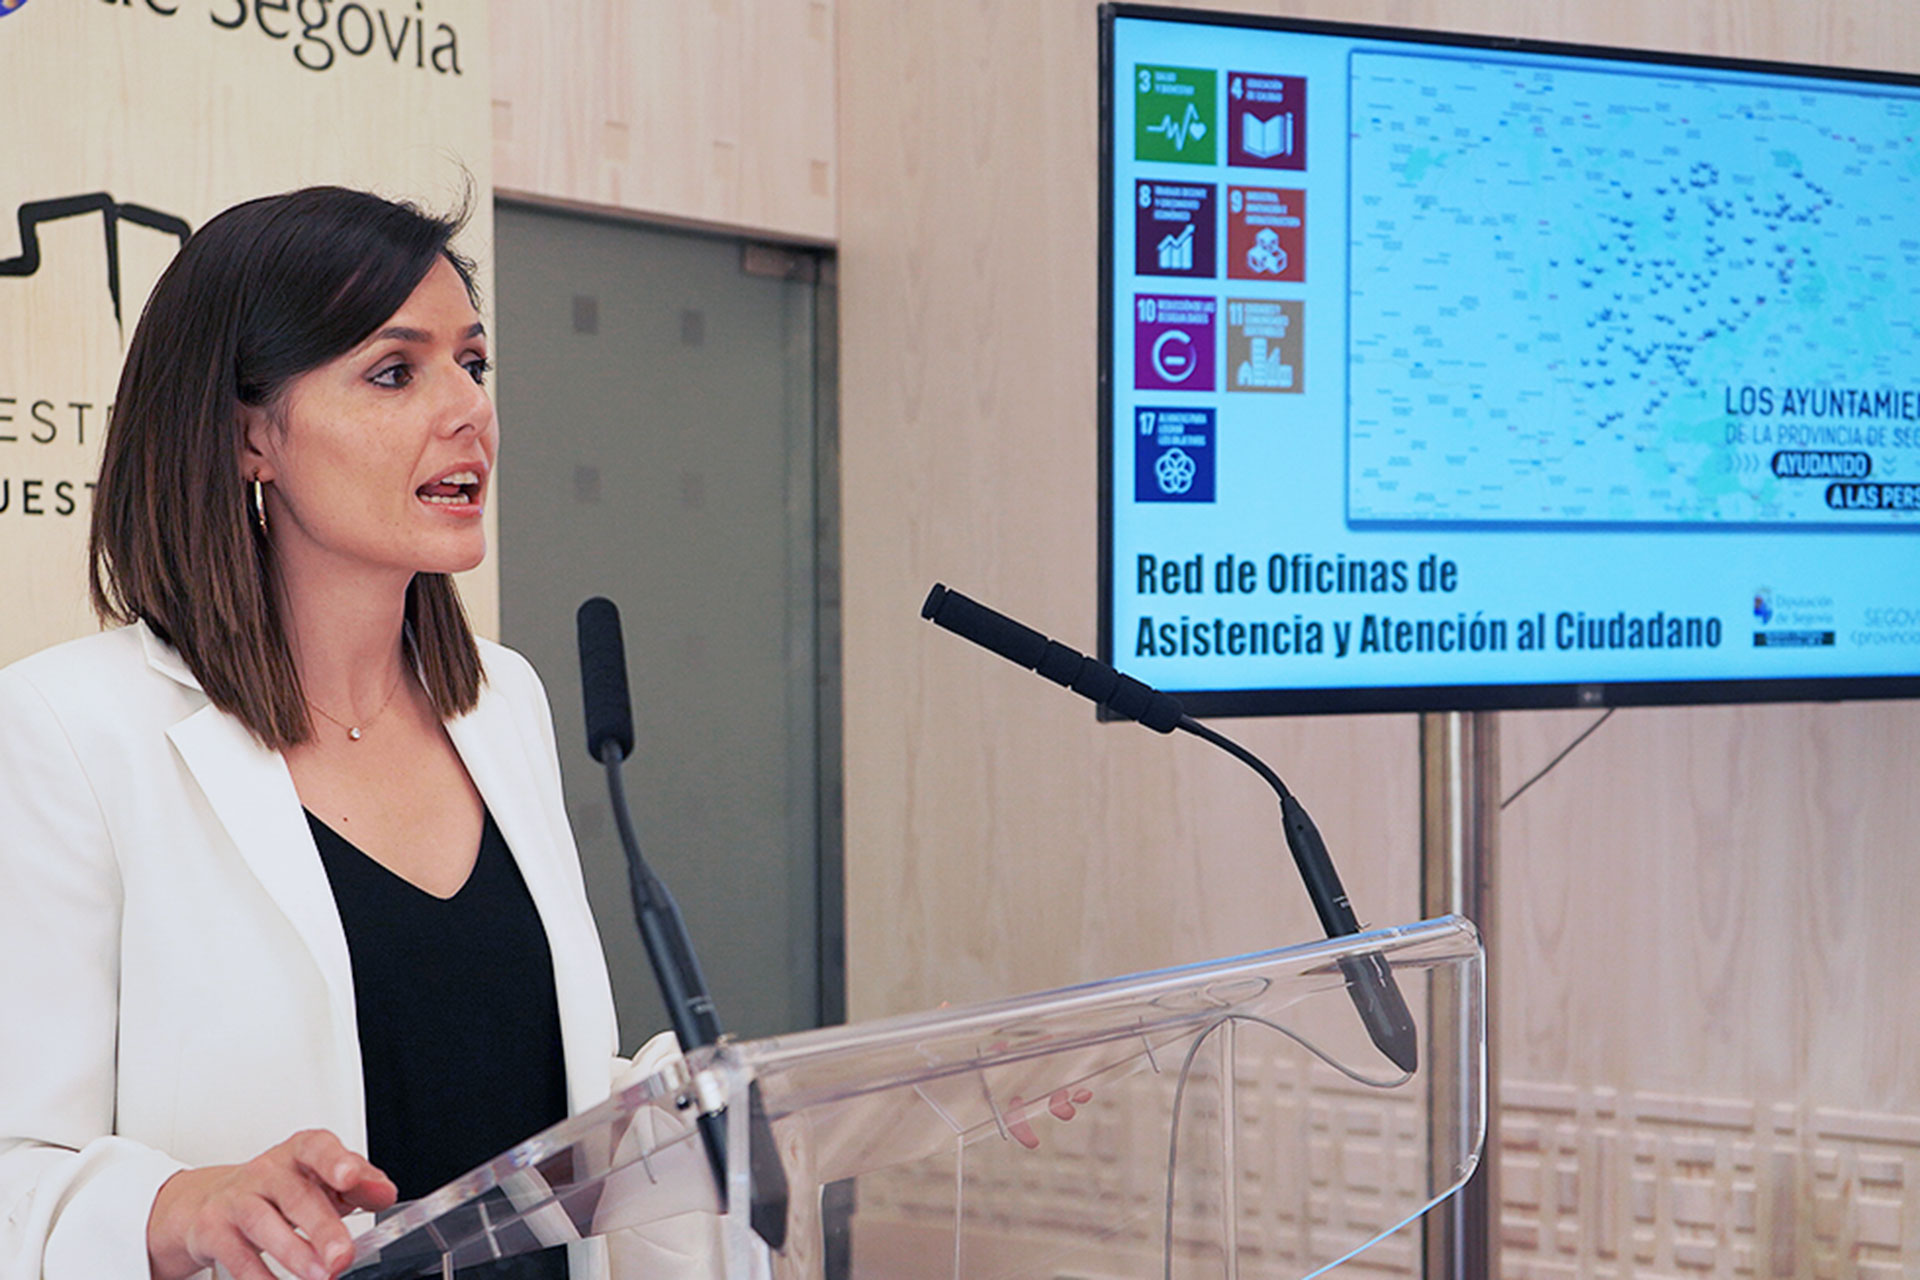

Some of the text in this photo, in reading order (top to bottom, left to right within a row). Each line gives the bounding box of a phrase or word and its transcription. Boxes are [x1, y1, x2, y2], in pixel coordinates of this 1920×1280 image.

[1138, 69, 1152, 93] 3
[1231, 76, 1244, 100] 4
[1139, 184, 1152, 208] 8
[1230, 189, 1243, 213] 9
[1137, 298, 1157, 323] 10
[1229, 302, 1243, 326] 11
[1726, 386, 1920, 421] LOS AYUNTAMIE
[0, 398, 114, 445] EST
[1139, 412, 1156, 435] 17
[1726, 423, 1745, 445] DE
[1753, 424, 1772, 445] LA
[1778, 424, 1862, 446] PROVINCIA
[1866, 426, 1888, 447] DE
[1776, 453, 1868, 477] AYUDANDO
[1831, 485, 1844, 508] A
[1846, 485, 1879, 508] LAS
[1137, 554, 1458, 594] Red de Oficinas de
[1135, 611, 1721, 657] Asistencia y Atención al Ciudadano
